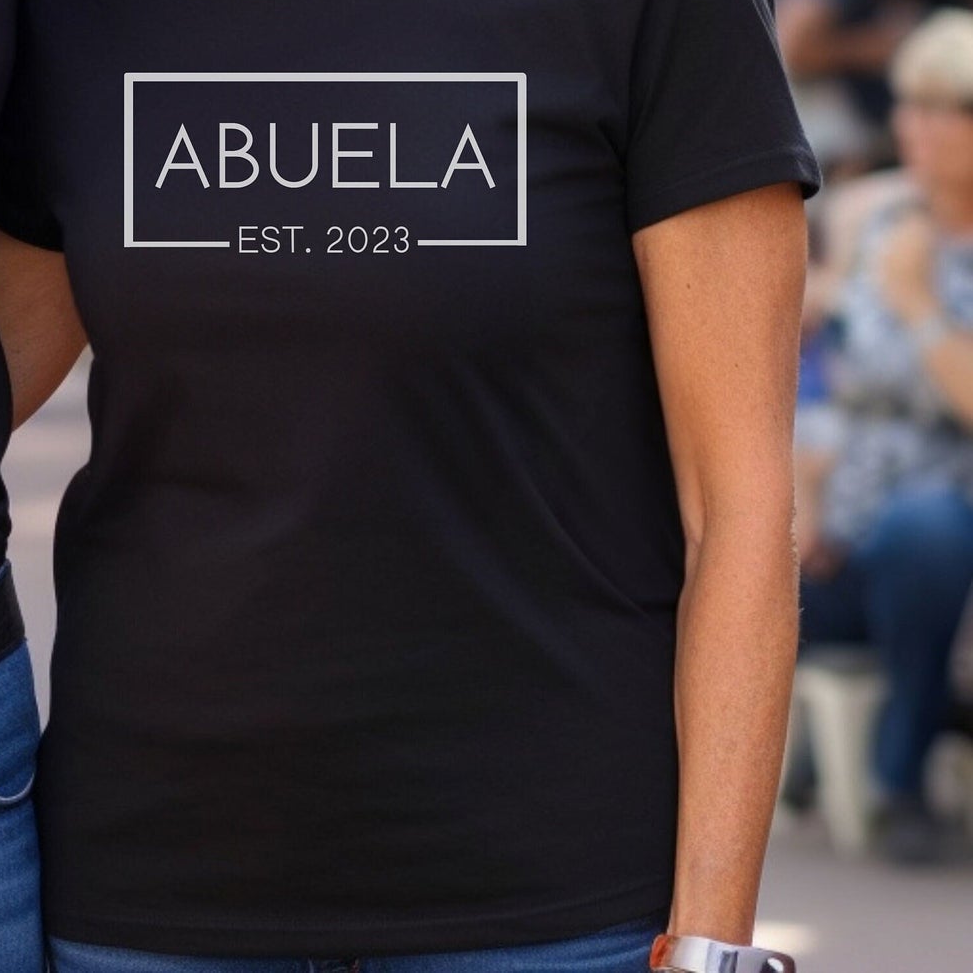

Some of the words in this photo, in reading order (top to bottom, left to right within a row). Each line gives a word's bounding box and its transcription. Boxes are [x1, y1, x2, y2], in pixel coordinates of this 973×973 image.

[154, 122, 496, 189] ABUELA
[238, 225, 311, 254] EST.
[326, 225, 410, 254] 2023
